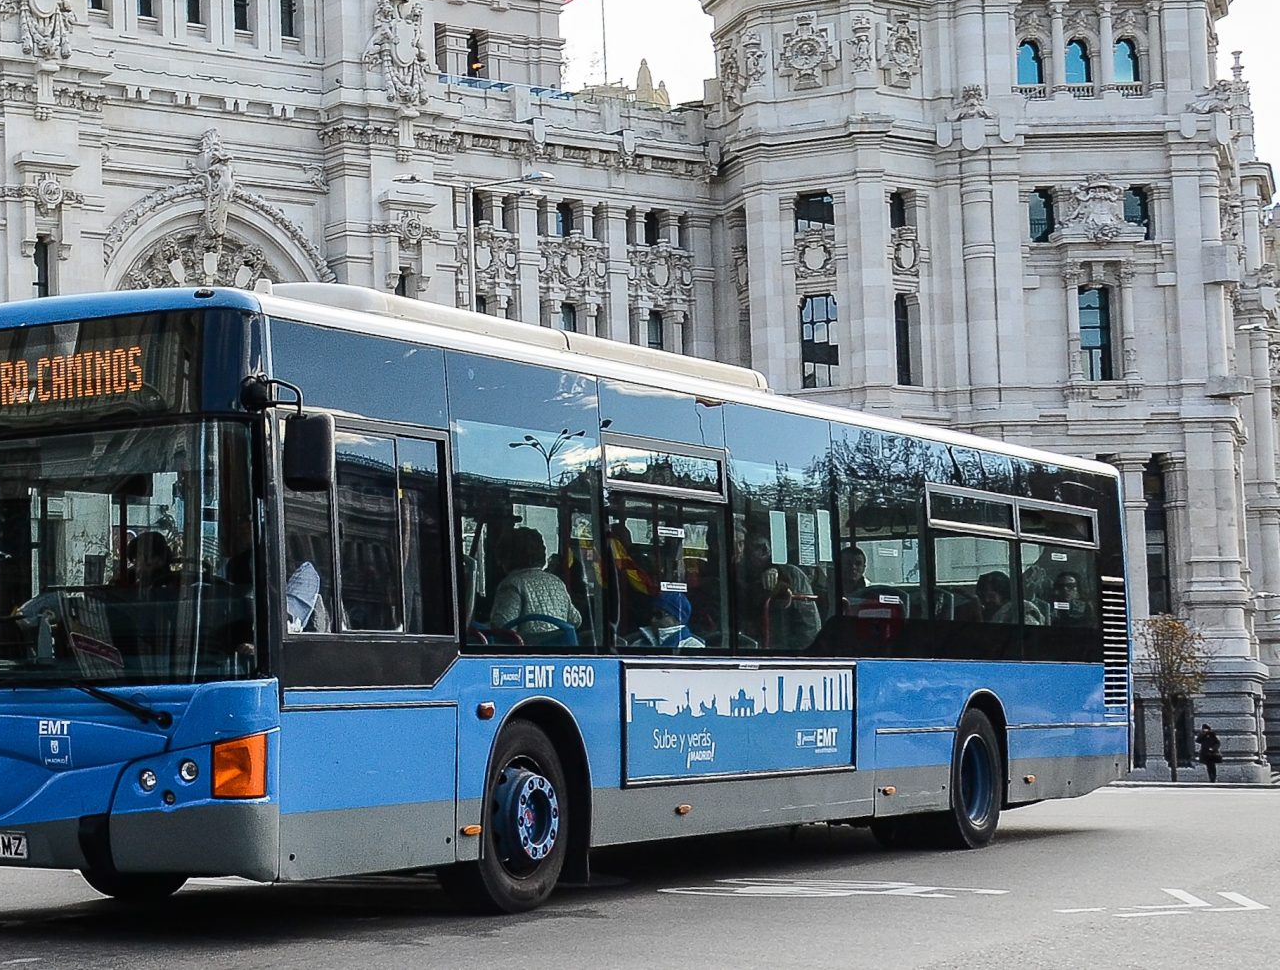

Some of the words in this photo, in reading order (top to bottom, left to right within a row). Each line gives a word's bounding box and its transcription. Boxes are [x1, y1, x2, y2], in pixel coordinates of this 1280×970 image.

[36, 346, 144, 402] CAMINOS
[525, 665, 555, 688] EMT
[562, 665, 595, 688] 6650
[39, 720, 71, 735] EMT
[816, 728, 838, 747] EMT
[653, 728, 678, 750] Sube
[679, 733, 686, 753] y
[687, 727, 712, 747] verás
